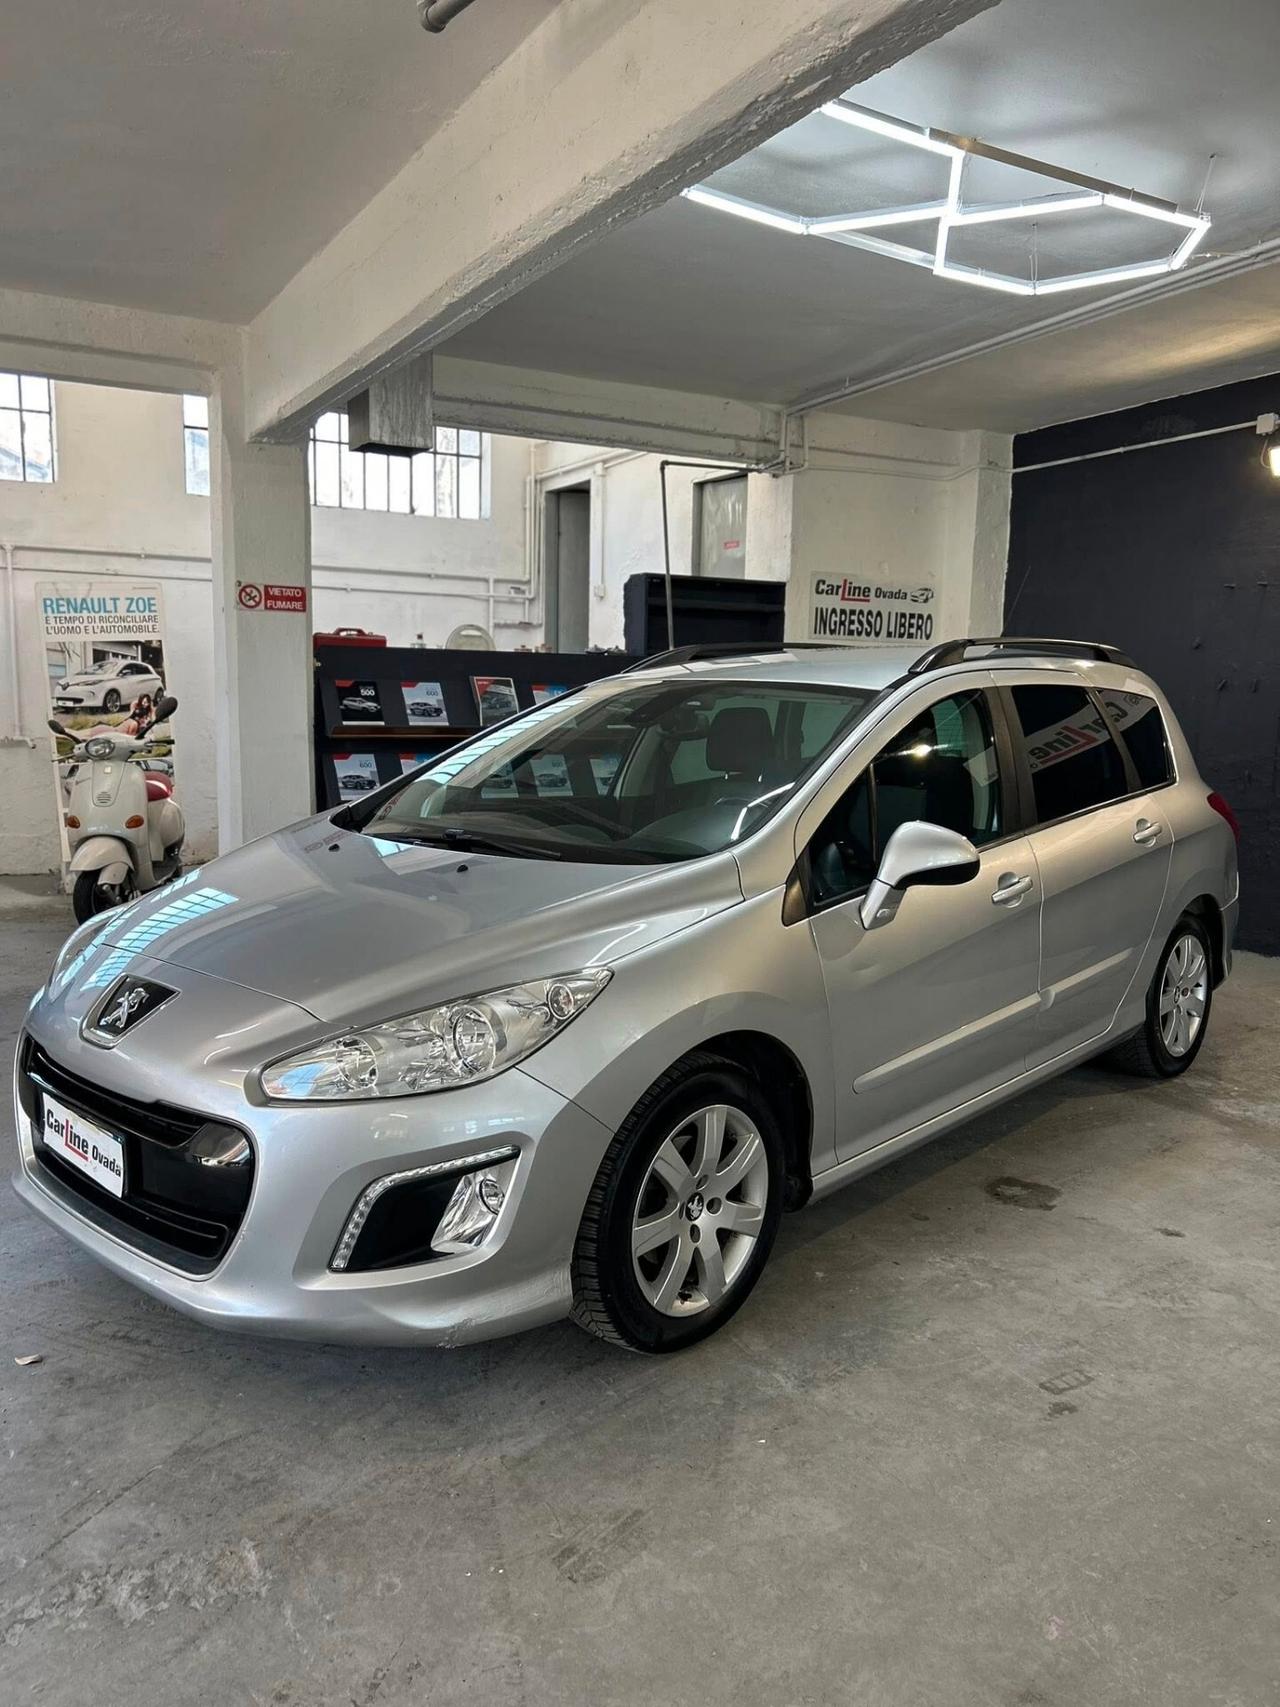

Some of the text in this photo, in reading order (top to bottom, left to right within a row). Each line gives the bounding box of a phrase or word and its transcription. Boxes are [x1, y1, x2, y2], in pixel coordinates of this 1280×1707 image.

[268, 587, 302, 598] VIETATO
[815, 578, 908, 602] CarLine Ovada
[43, 597, 158, 615] RENAULT ZOE
[267, 600, 304, 610] FUMARE
[54, 616, 84, 625] TEMPO
[87, 616, 97, 625] DI
[98, 615, 159, 624] RICONCILIARE
[814, 606, 934, 640] INGRESSO LIBERO
[46, 624, 160, 635] L'UOMO E L'AUTOMOBILE.
[46, 1108, 121, 1177] CarLine Ovada
